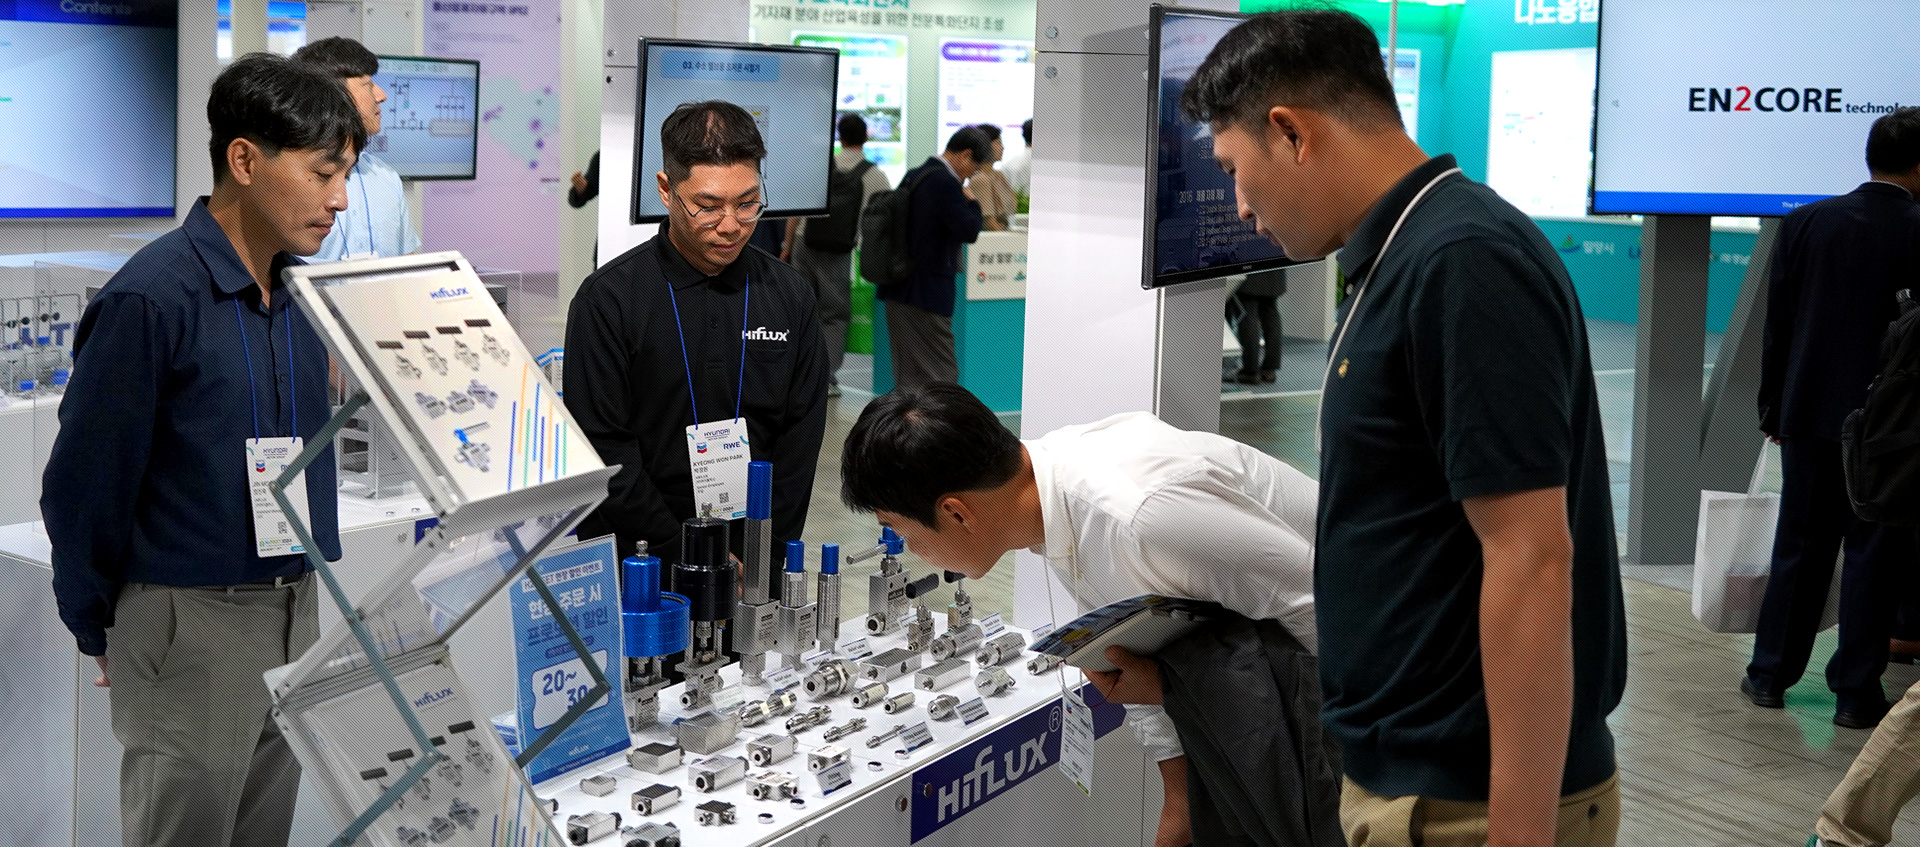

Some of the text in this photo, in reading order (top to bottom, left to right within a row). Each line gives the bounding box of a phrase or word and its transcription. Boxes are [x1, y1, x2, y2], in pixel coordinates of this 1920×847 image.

[60, 0, 132, 15] Contents
[1688, 86, 1842, 113] EN2CORE
[723, 441, 741, 450] RWE
[693, 458, 715, 467] KYEONG
[559, 587, 585, 610] 주문
[588, 582, 602, 602] 시
[582, 605, 609, 629] 할인
